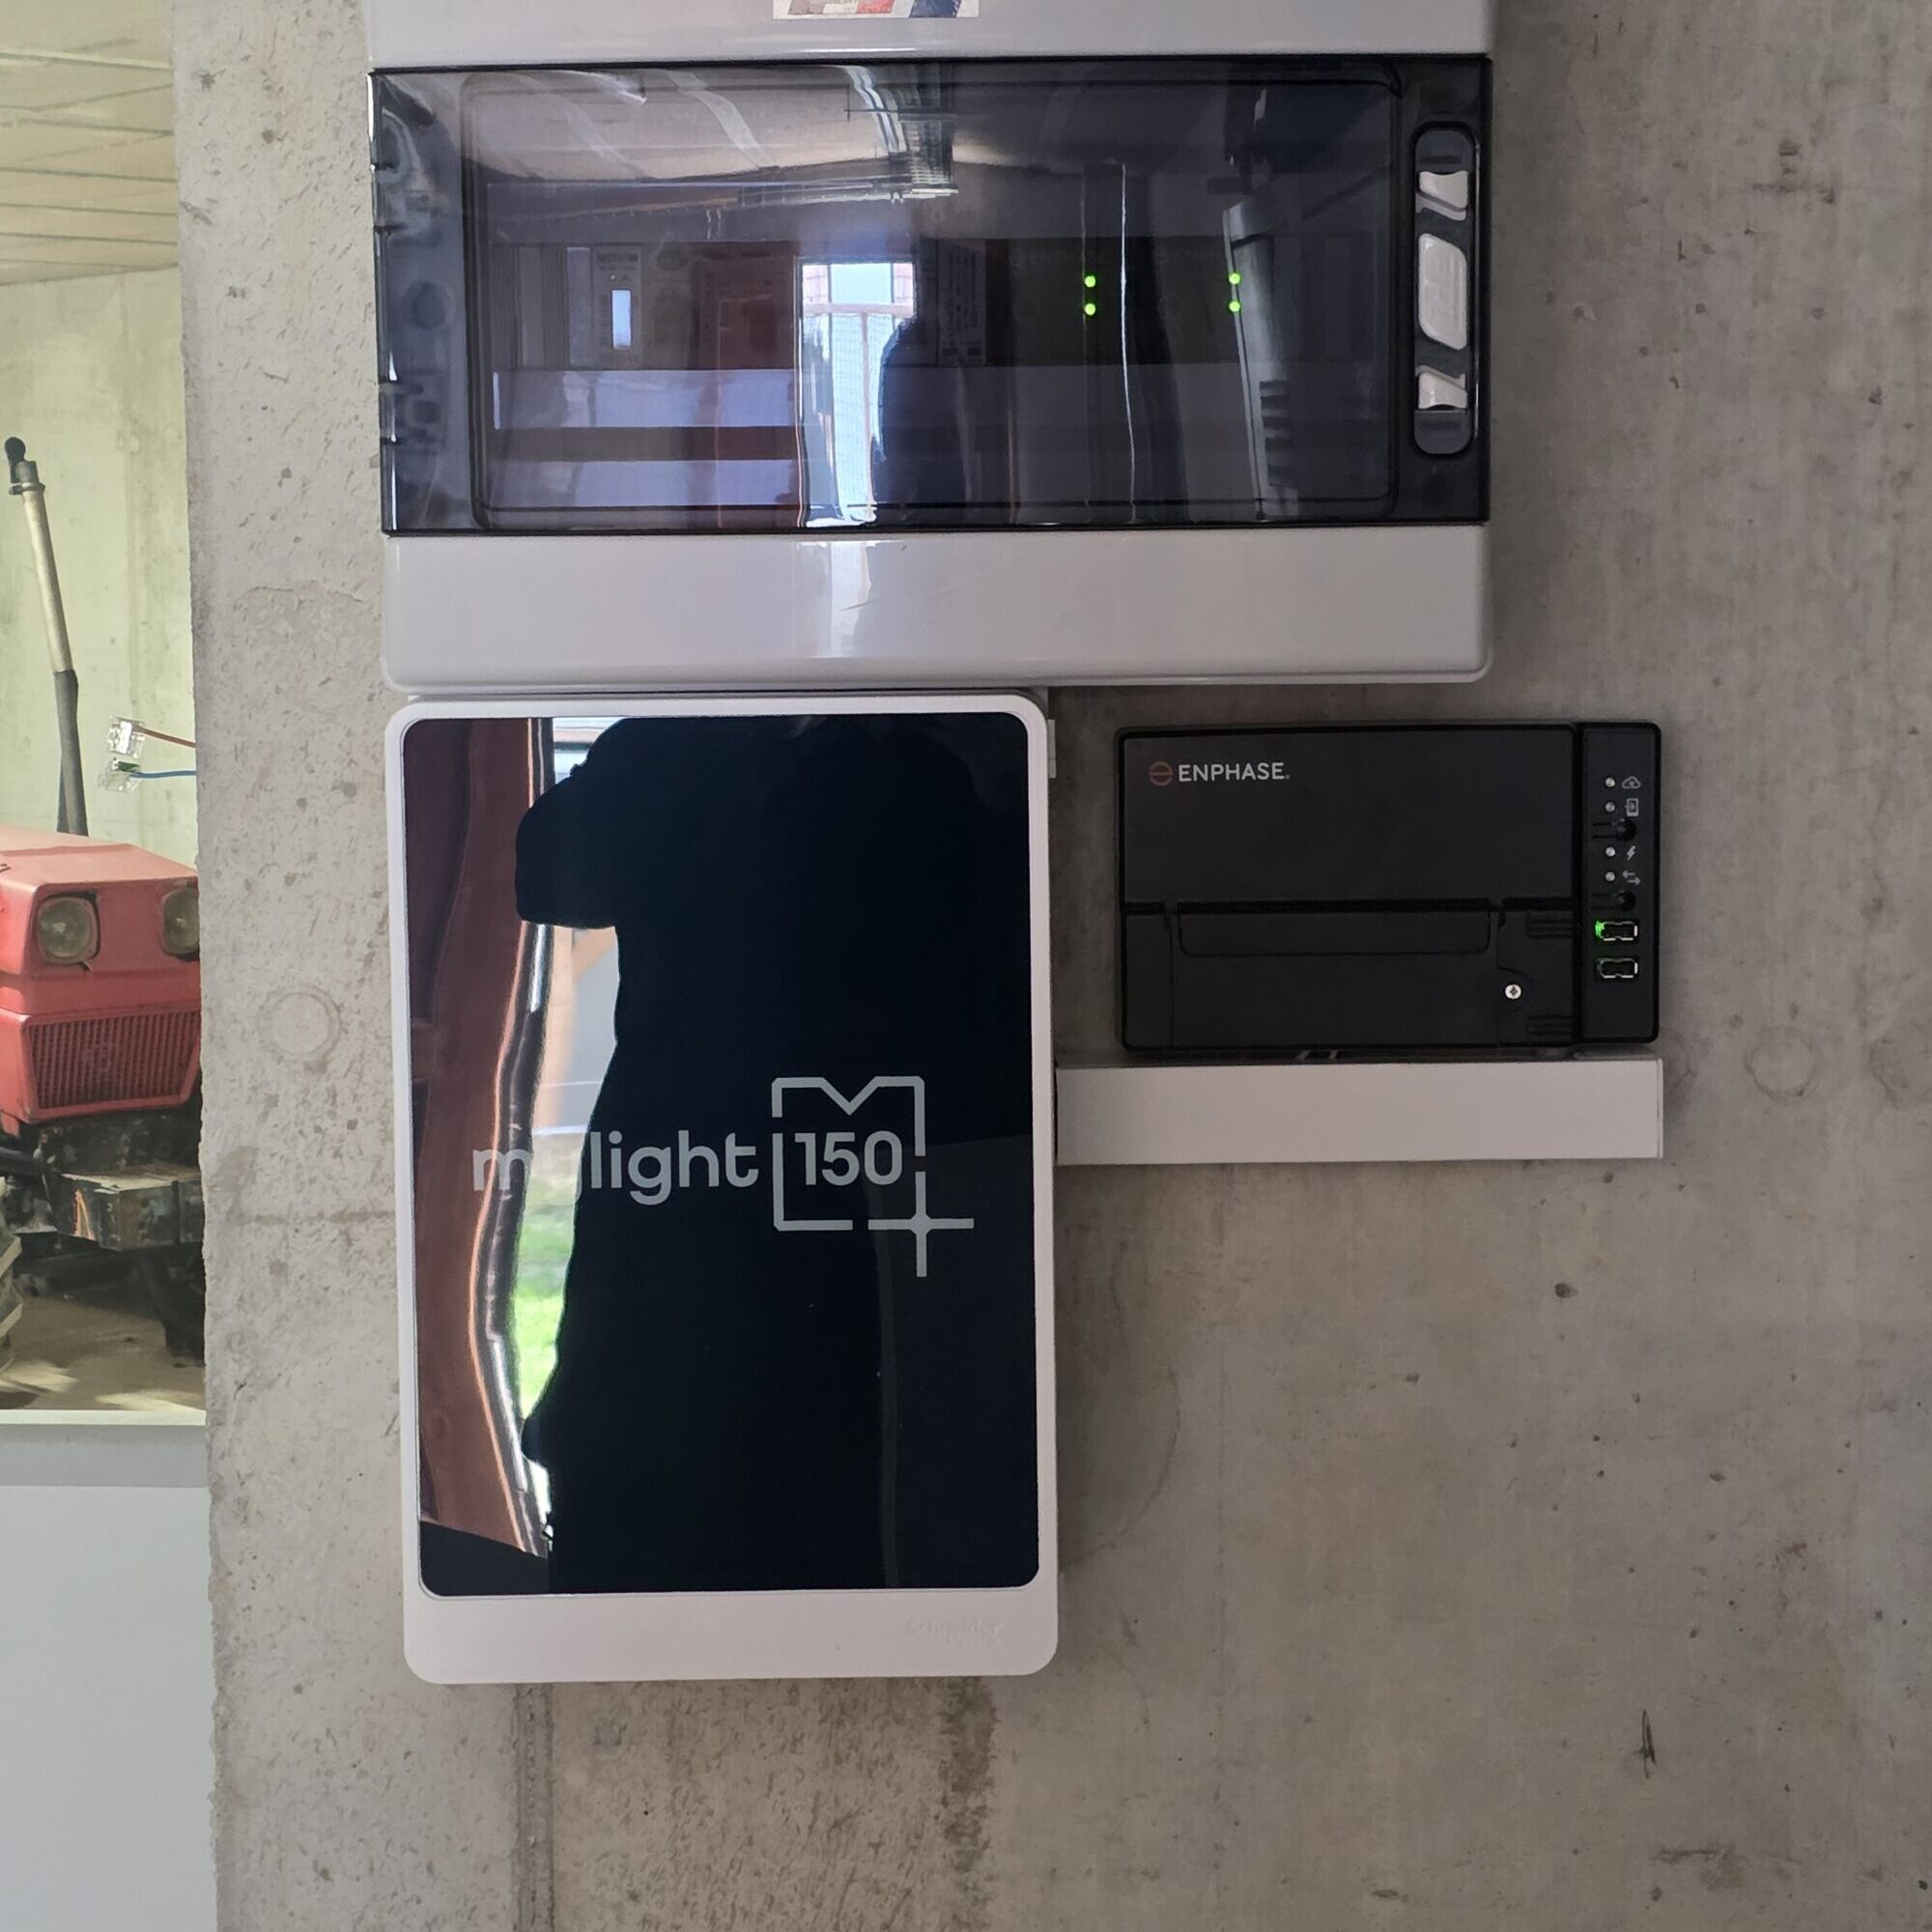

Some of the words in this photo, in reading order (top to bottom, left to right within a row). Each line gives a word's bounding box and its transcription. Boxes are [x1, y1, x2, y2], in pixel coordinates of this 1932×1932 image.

[1178, 761, 1286, 782] ENPHASE
[471, 1130, 759, 1206] mlight
[794, 1130, 903, 1186] 150
